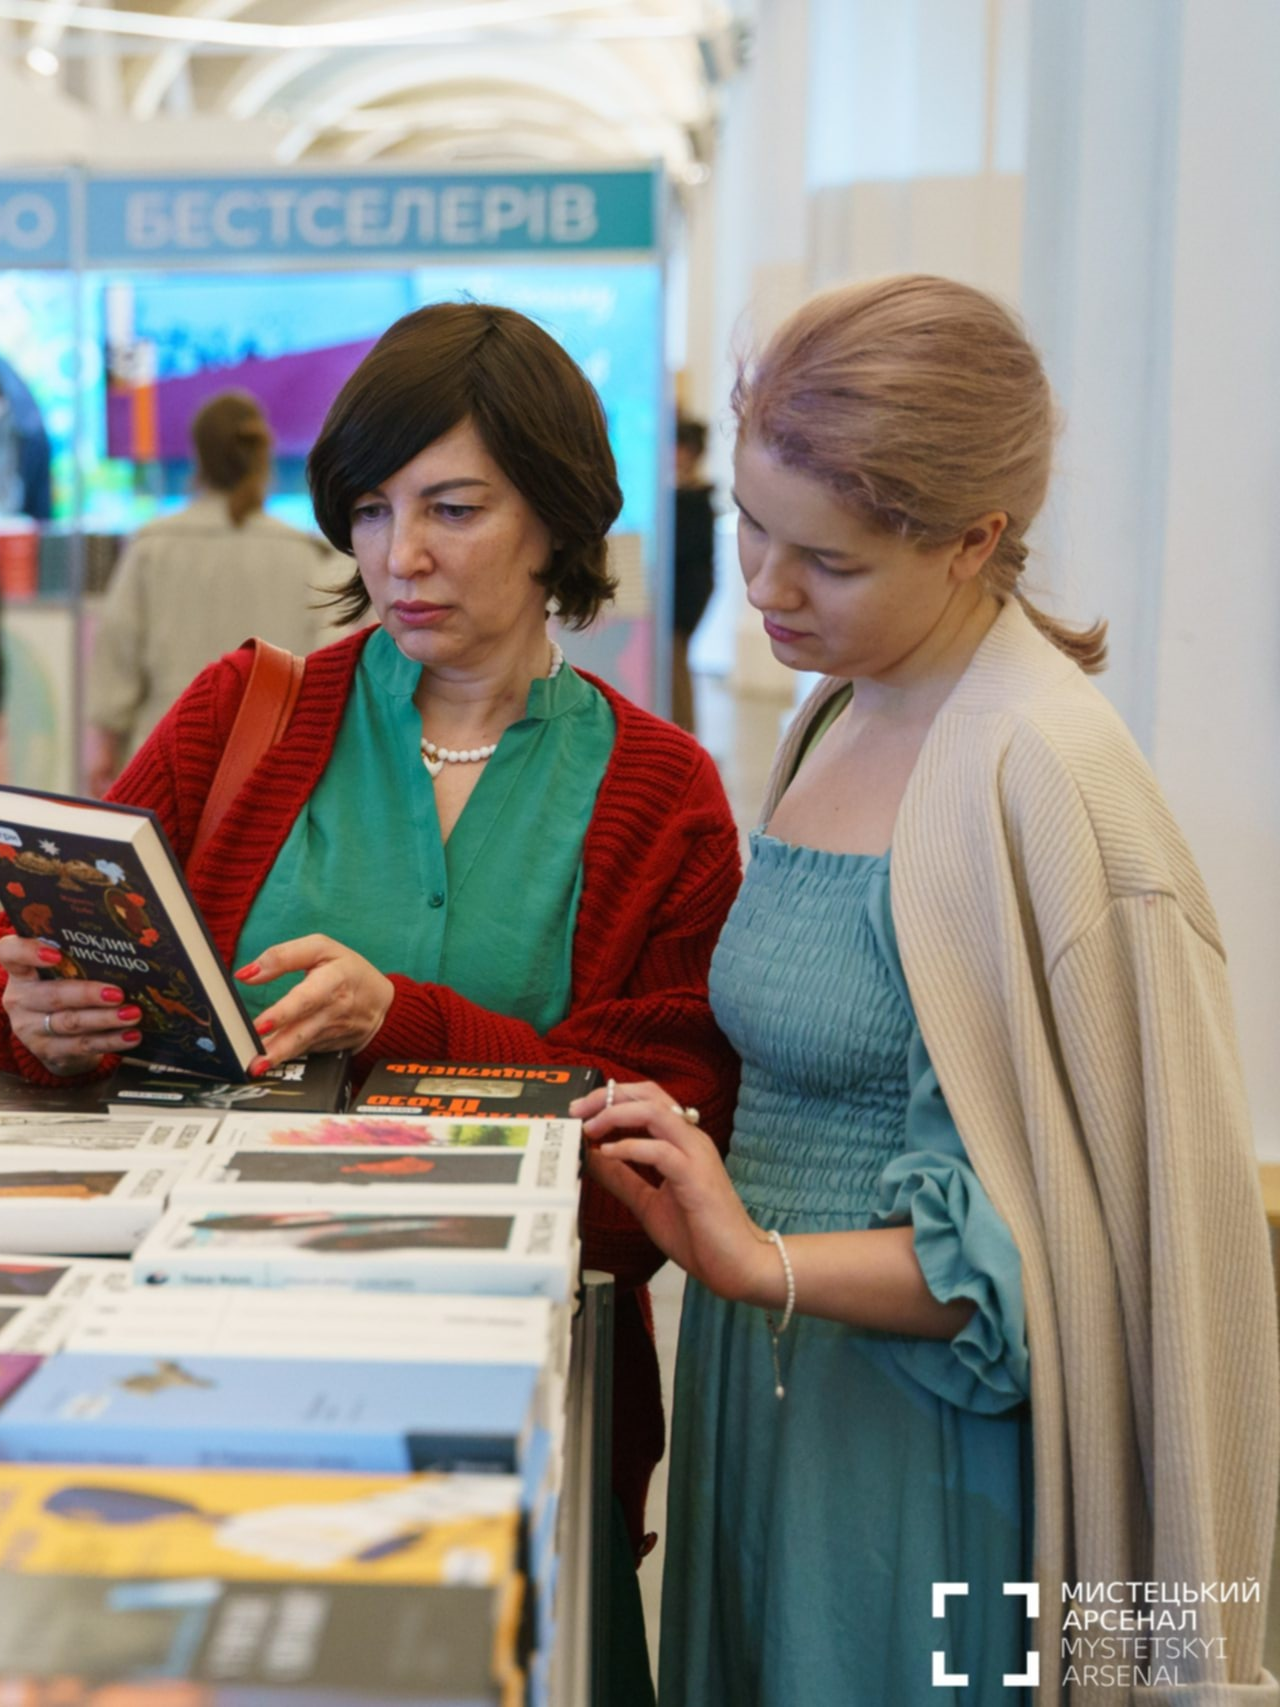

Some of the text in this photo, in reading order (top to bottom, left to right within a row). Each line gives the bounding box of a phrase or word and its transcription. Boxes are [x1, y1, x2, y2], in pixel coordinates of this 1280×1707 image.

[125, 184, 600, 249] БЕСТСЕЛЕРІВ
[61, 928, 137, 955] ПОКЛИЧ
[68, 945, 150, 973] ЛИСИЦЮ
[385, 1063, 570, 1085] Сицилієць
